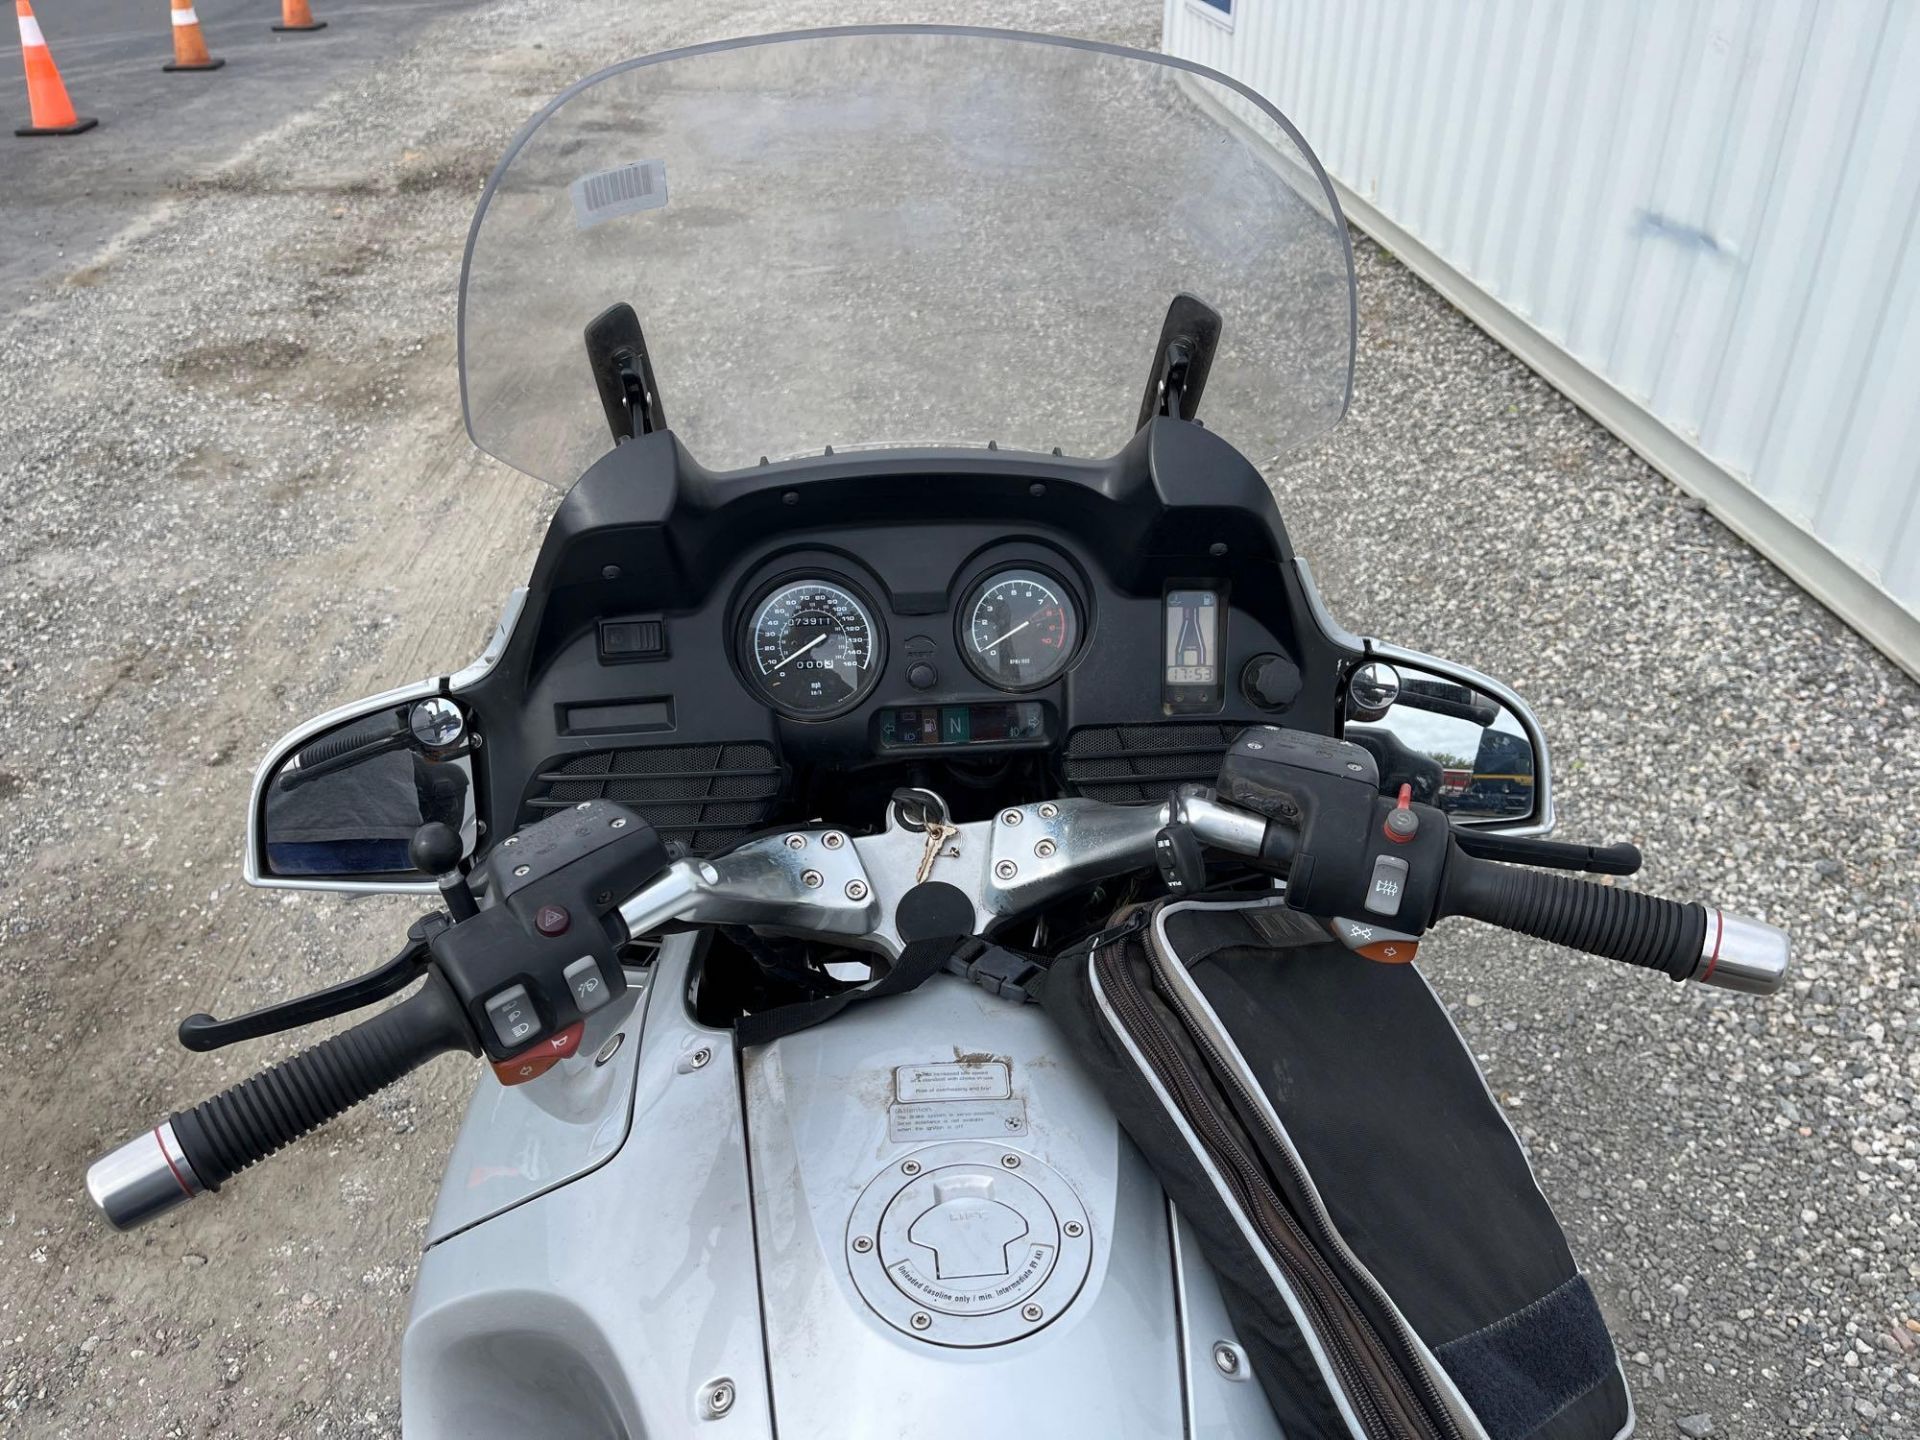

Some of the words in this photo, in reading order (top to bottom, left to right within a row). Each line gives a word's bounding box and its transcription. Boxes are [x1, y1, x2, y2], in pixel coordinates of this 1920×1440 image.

[788, 618, 830, 626] 073911
[950, 717, 961, 734] N
[898, 1266, 922, 1289] Unleaded
[923, 1285, 951, 1301] Gasoline
[955, 1295, 970, 1303] only
[978, 1293, 994, 1301] min.
[996, 1269, 1032, 1296] Intermediate
[1034, 1250, 1044, 1260] AKI
